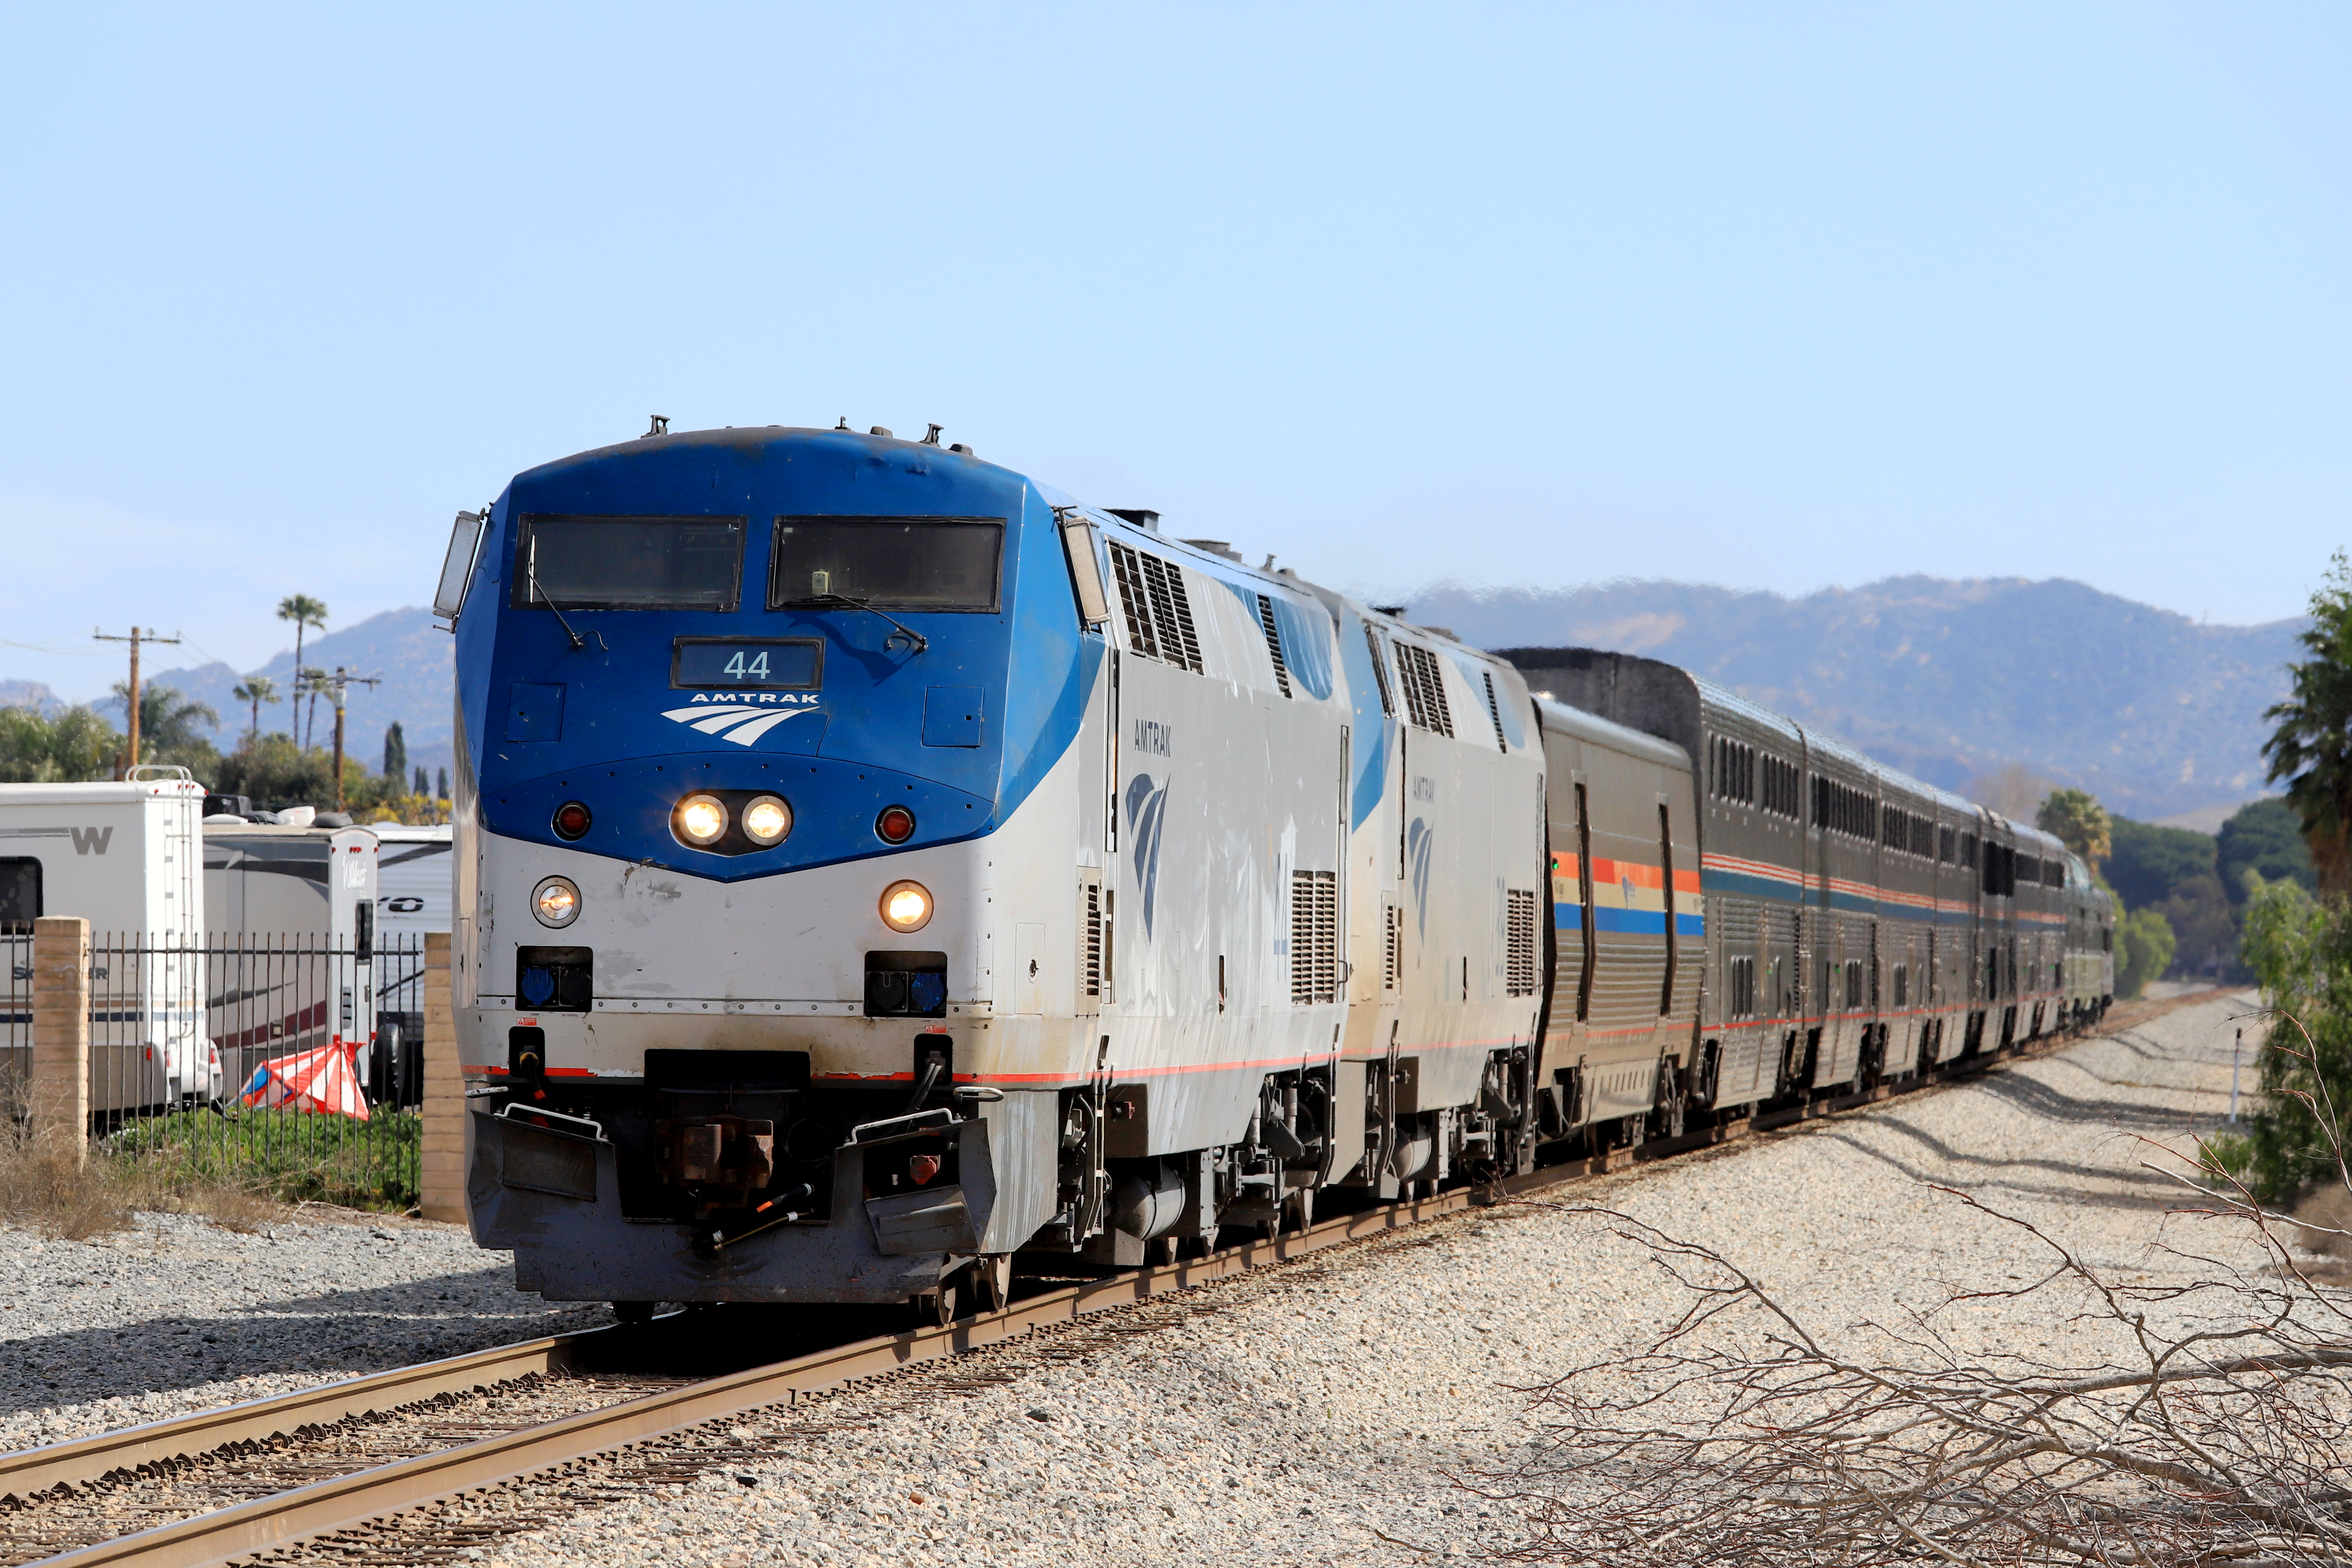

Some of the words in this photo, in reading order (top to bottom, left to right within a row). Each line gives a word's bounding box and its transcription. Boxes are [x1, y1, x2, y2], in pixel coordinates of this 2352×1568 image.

[723, 651, 770, 679] 44
[690, 693, 819, 704] AMTRAK
[1134, 718, 1171, 758] AMTRAK
[1413, 775, 1435, 804] AMTRAK
[69, 826, 114, 855] W
[342, 854, 368, 891] Wildcat
[1274, 852, 1288, 982] 44
